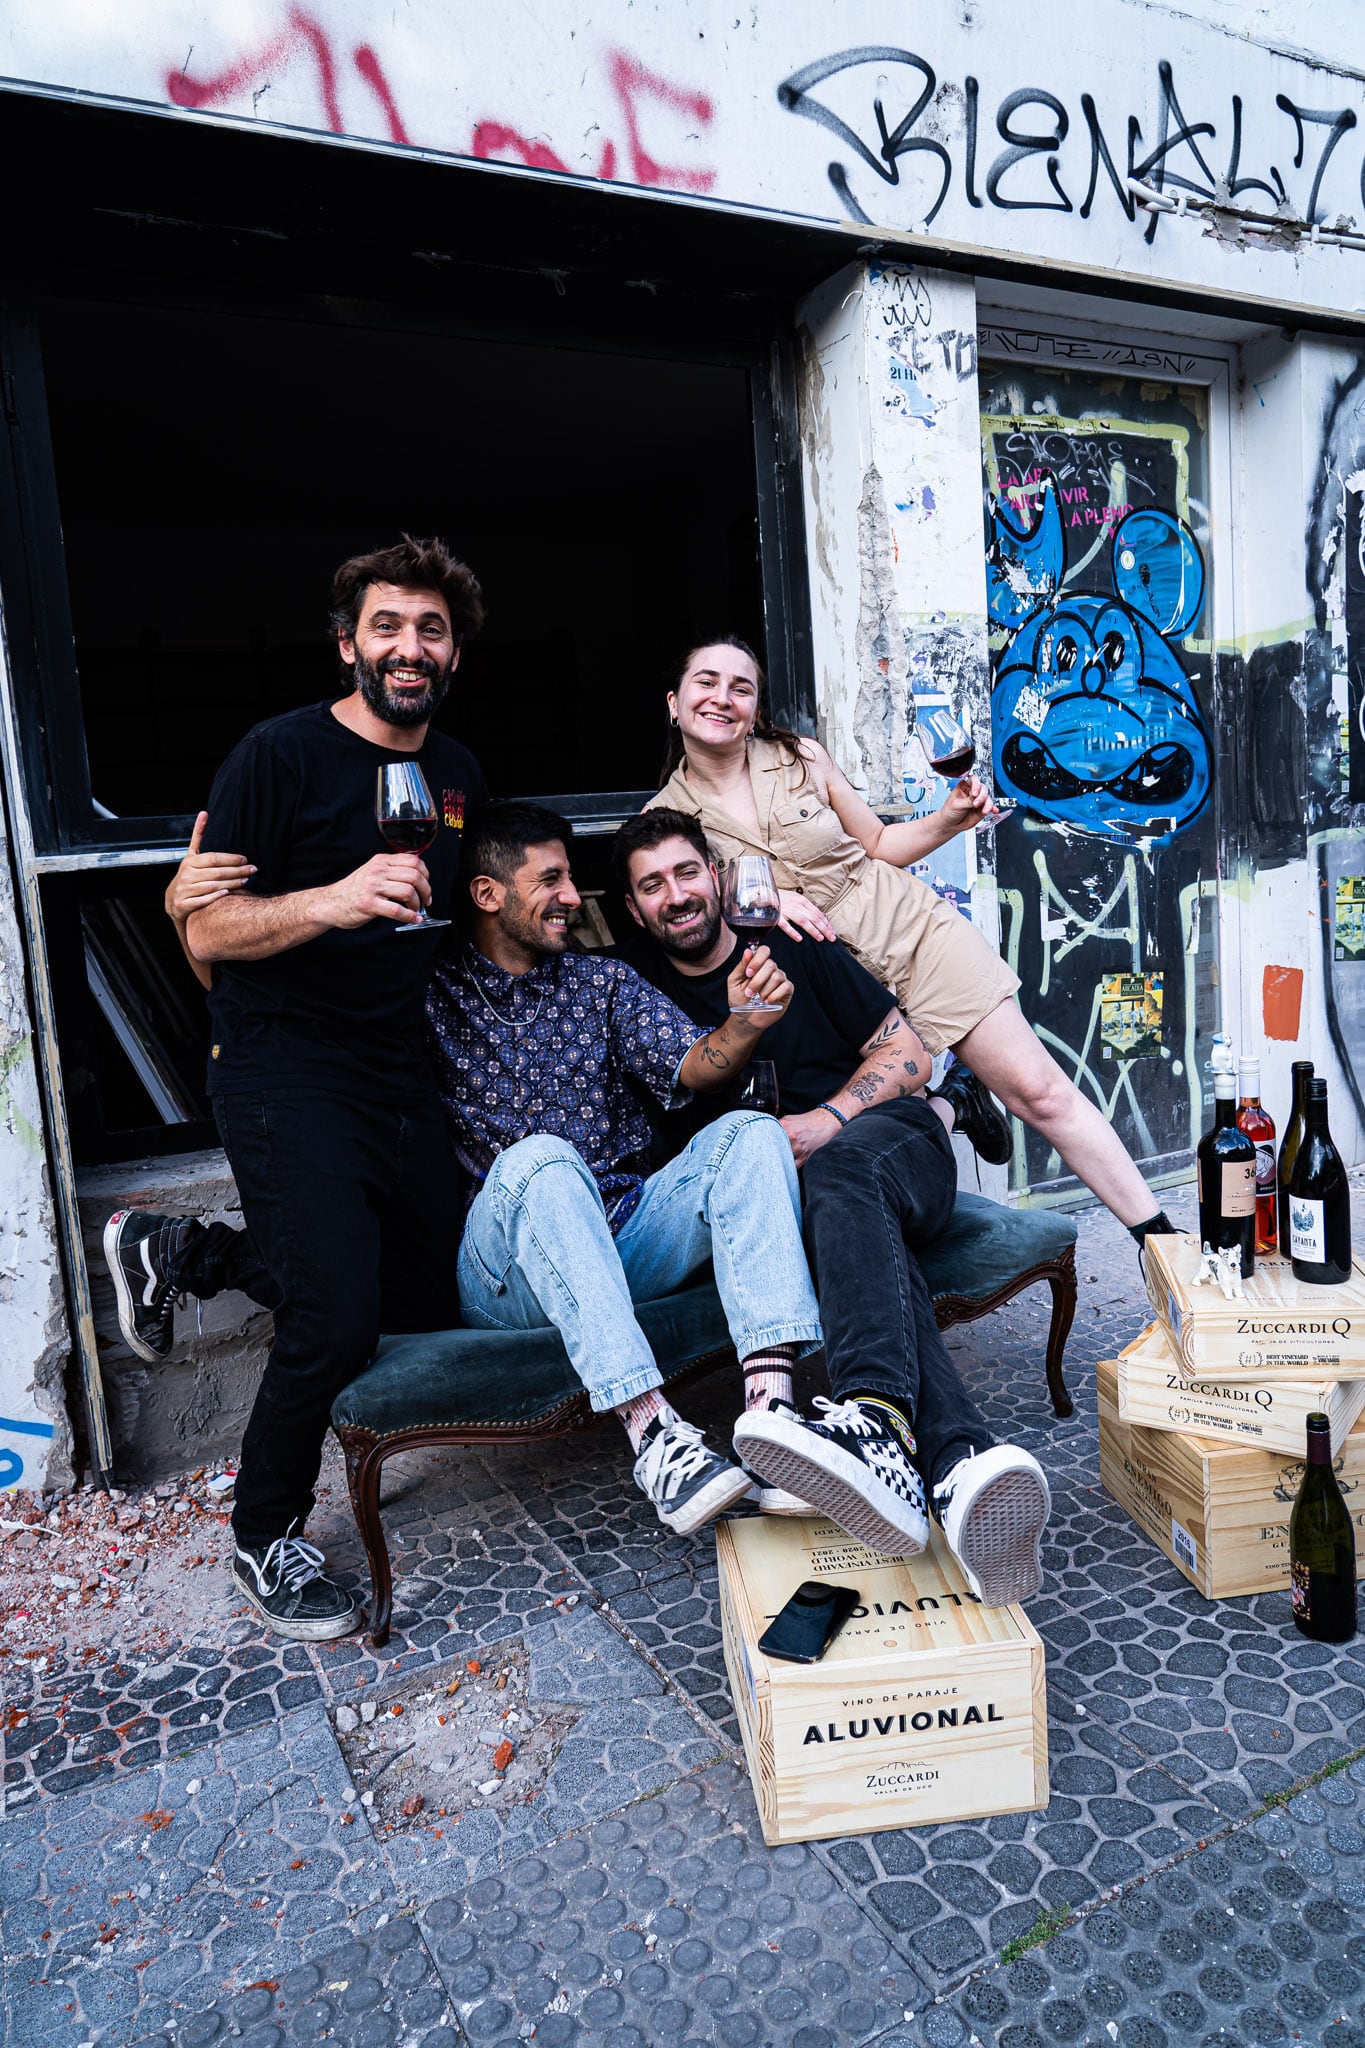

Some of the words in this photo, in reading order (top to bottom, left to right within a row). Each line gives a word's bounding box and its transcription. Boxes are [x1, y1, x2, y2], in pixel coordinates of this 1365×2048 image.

[1237, 1319, 1326, 1334] ZUCCARDI
[1332, 1317, 1351, 1340] Q
[1166, 1374, 1250, 1402] ZUCCARDI
[1255, 1389, 1273, 1413] Q
[1193, 1412, 1207, 1420] BEST
[1207, 1415, 1233, 1424] VINEYARD
[1212, 1422, 1233, 1430] WORLD
[811, 1554, 857, 1564] WORLD
[875, 1555, 905, 1566] BEST
[813, 1560, 872, 1572] VINEYARD
[915, 1620, 947, 1628] VINO
[839, 1628, 880, 1637] PARA
[842, 1697, 873, 1707] VINO
[882, 1694, 898, 1703] DE
[907, 1687, 959, 1700] PARAJE
[803, 1703, 1005, 1745] ALUVIONAL
[866, 1770, 939, 1788] ZUCCARDI
